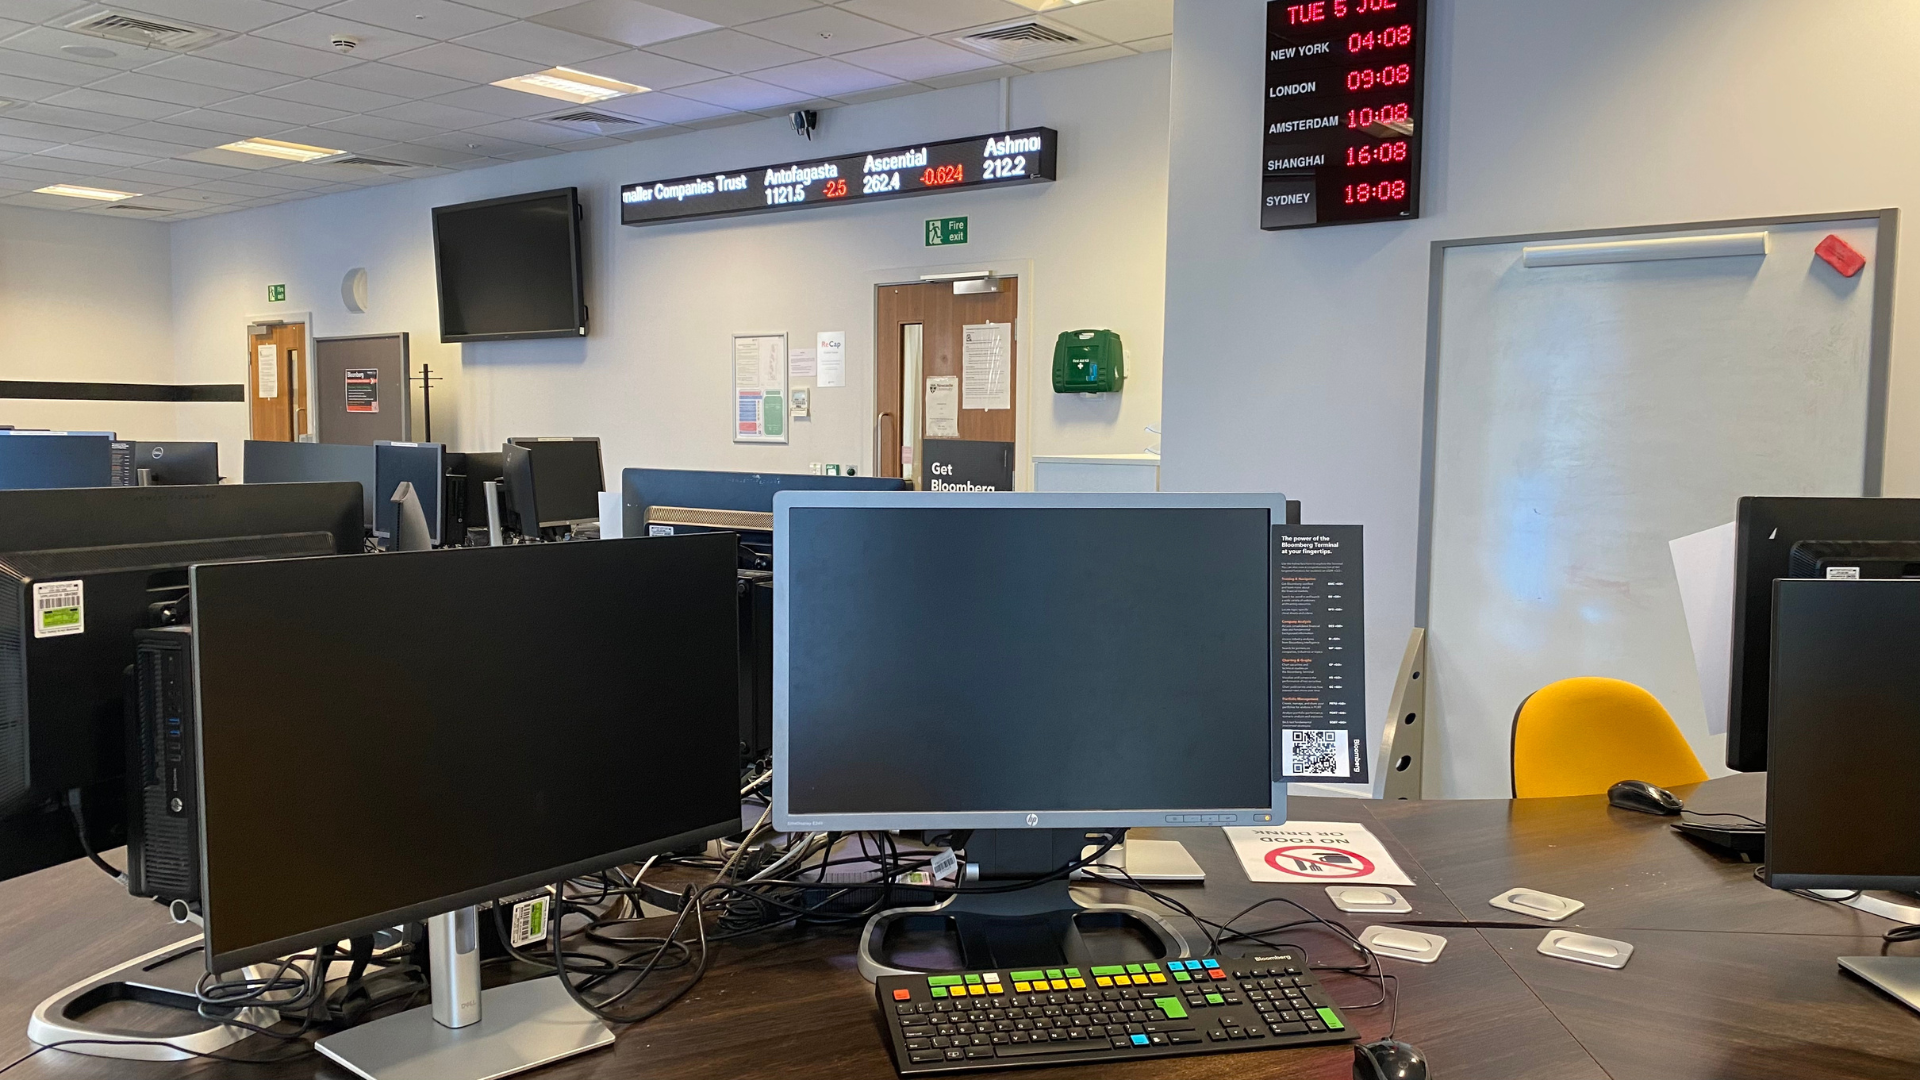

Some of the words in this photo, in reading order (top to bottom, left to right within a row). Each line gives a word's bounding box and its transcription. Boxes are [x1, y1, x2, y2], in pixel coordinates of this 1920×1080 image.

[1287, 1, 1325, 24] TUE
[1334, 0, 1347, 17] 5
[1271, 47, 1296, 61] NEW
[1298, 42, 1330, 56] YORK
[1348, 25, 1411, 53] 04:08
[1270, 82, 1316, 98] LONDON
[1348, 64, 1409, 90] 09:08
[1269, 116, 1339, 134] AMSTERDAM
[1347, 103, 1408, 128] 10:08
[863, 147, 928, 173] Ascential
[982, 155, 1026, 179] 212.2
[1268, 155, 1325, 170] SHANGHAI
[1347, 142, 1406, 166] 16:08
[654, 179, 714, 201] Companies
[715, 174, 747, 192] Trust
[764, 163, 838, 187] Antofagasta
[863, 172, 901, 194] 262.4
[920, 164, 964, 186] -0.624
[765, 184, 805, 205] 1121.5
[823, 179, 847, 198] -2.5
[1266, 193, 1310, 206] SYDNEY
[1345, 180, 1405, 204] 18:08
[949, 221, 964, 230] Fire
[949, 231, 964, 241] exit
[931, 462, 953, 475] Get
[1353, 739, 1361, 773] Bloomberg
[1026, 813, 1038, 827] hp
[1252, 829, 1311, 837] DRINK
[1254, 954, 1292, 962] Bloomberg
